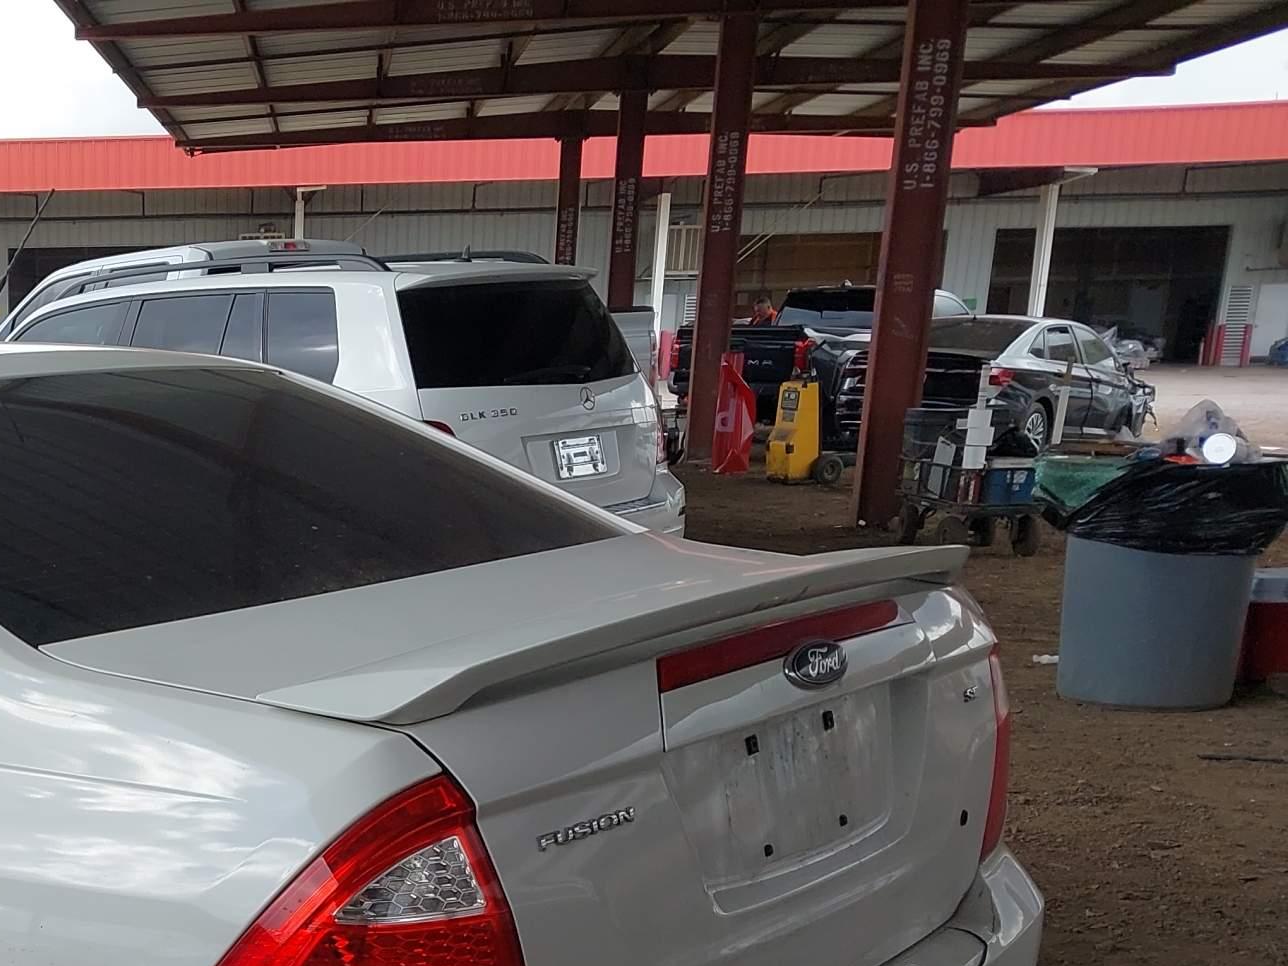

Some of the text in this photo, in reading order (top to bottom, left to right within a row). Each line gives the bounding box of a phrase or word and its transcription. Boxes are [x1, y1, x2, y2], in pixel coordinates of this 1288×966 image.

[917, 39, 934, 71] INC.
[908, 80, 928, 148] PREFAB
[920, 39, 951, 188] 1-866-799-0969
[713, 160, 726, 204] PREFAB
[807, 646, 841, 678] Ford
[535, 806, 636, 852] FUSION
